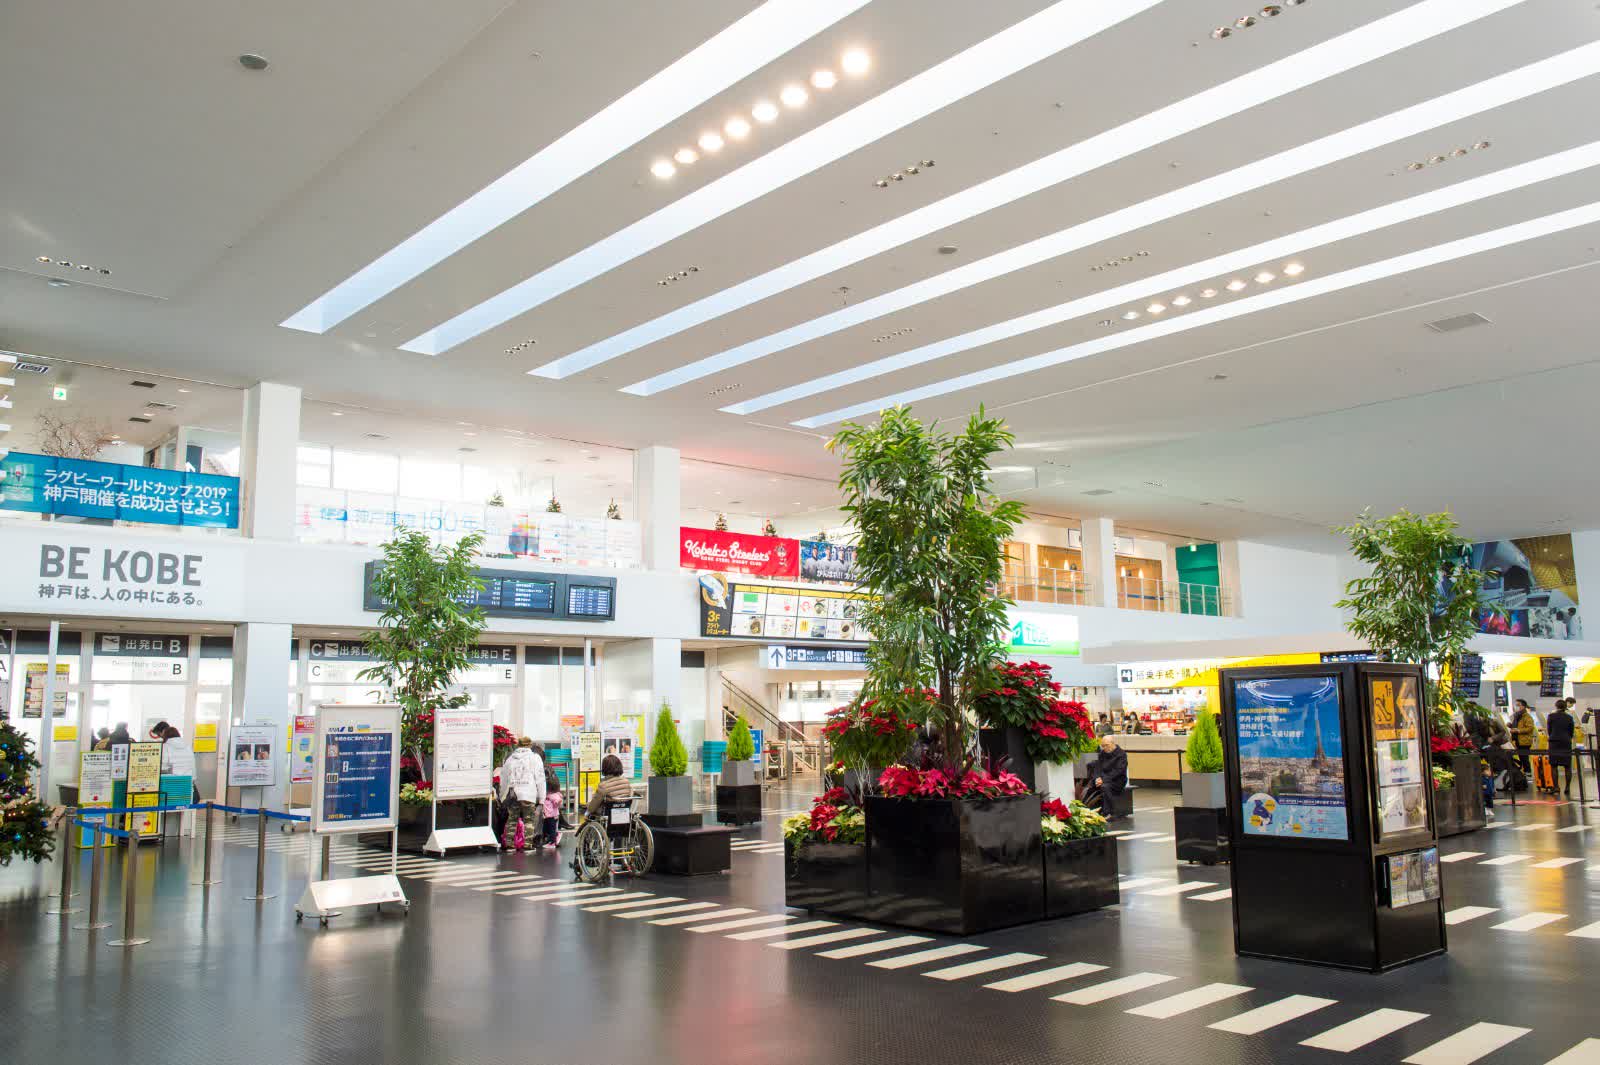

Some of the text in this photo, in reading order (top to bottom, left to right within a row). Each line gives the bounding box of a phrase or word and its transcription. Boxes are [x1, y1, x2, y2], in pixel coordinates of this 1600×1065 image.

[684, 539, 770, 563] Kobelco Steelers
[40, 544, 203, 587] BE KOBE
[38, 583, 204, 606] 神戸は、人の中にある。
[707, 610, 720, 622] 3F
[125, 639, 181, 653] 出発口 B
[311, 643, 322, 657] C
[503, 649, 511, 661] E
[172, 663, 182, 675] B
[311, 665, 321, 677] C
[505, 669, 512, 679] E
